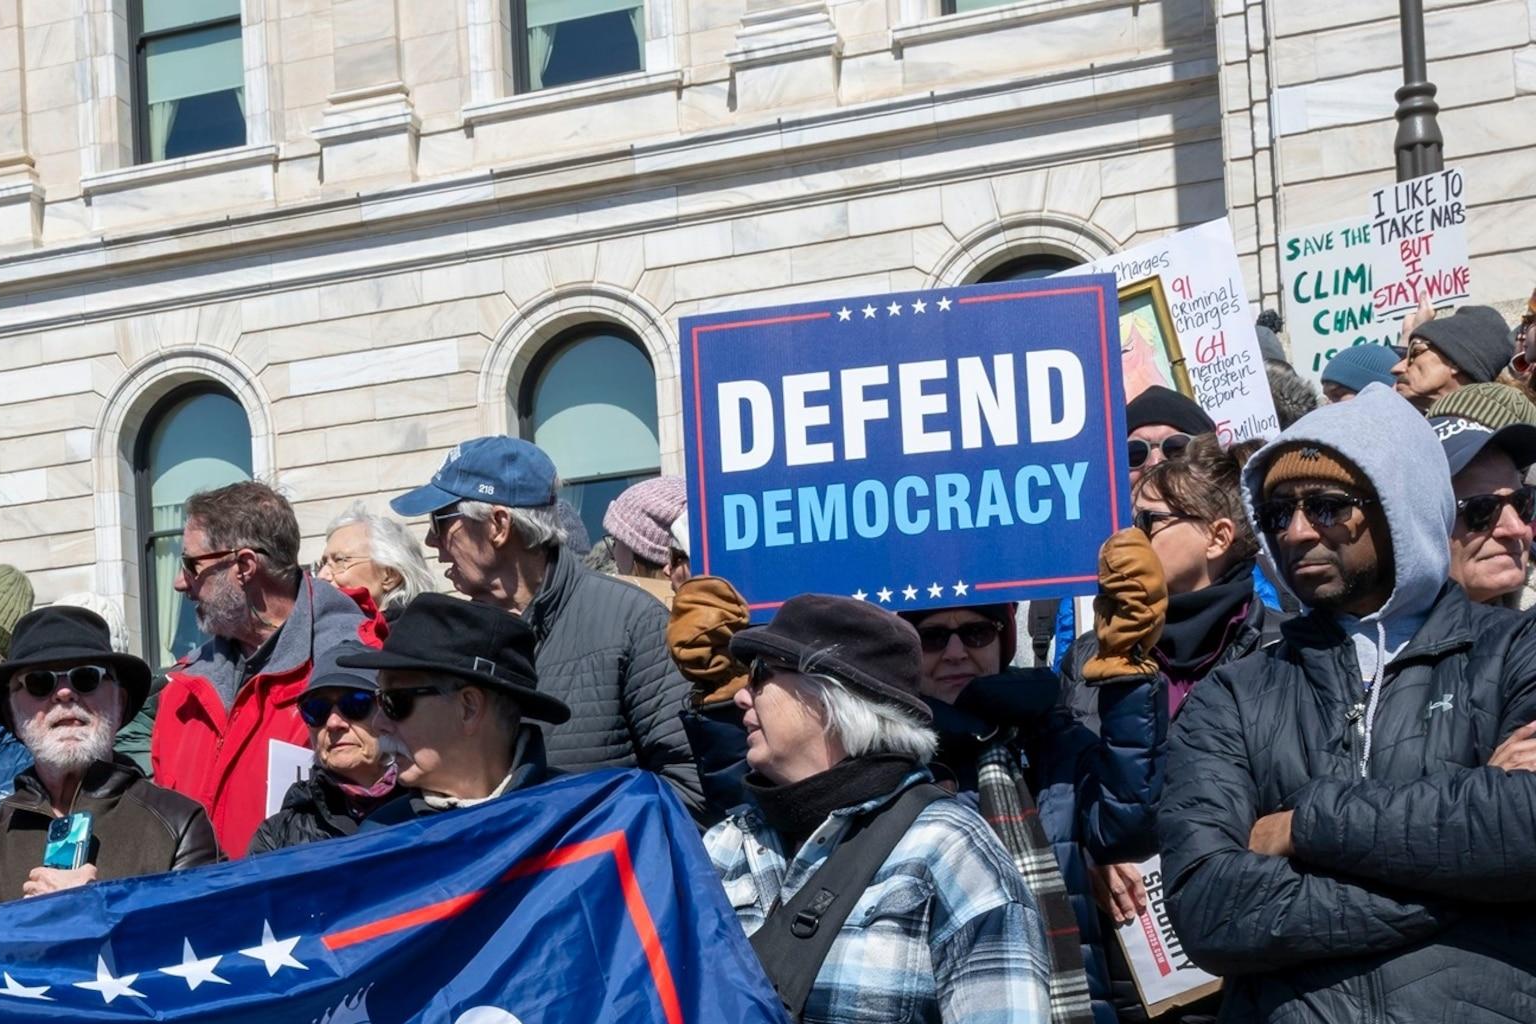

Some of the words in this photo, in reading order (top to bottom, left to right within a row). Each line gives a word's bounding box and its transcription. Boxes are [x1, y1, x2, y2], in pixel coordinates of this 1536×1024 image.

[1373, 190, 1385, 219] I
[1395, 177, 1436, 214] LIKE
[1441, 168, 1463, 202] TO
[1373, 210, 1424, 246] TAKE
[1431, 201, 1466, 232] NAPS
[1286, 231, 1334, 261] SAVE
[1341, 224, 1371, 248] THE
[1400, 233, 1434, 261] BUT
[1405, 258, 1423, 277] I
[1172, 275, 1193, 300] 91
[1373, 275, 1422, 309] STAY
[1424, 265, 1471, 300] WOKE
[1313, 302, 1375, 335] CHAN
[1195, 331, 1226, 363] 64
[1202, 364, 1256, 393] Epstein
[717, 349, 1087, 473] DEFEND
[478, 484, 495, 495] 218
[723, 461, 1089, 551] DEMOCRACY
